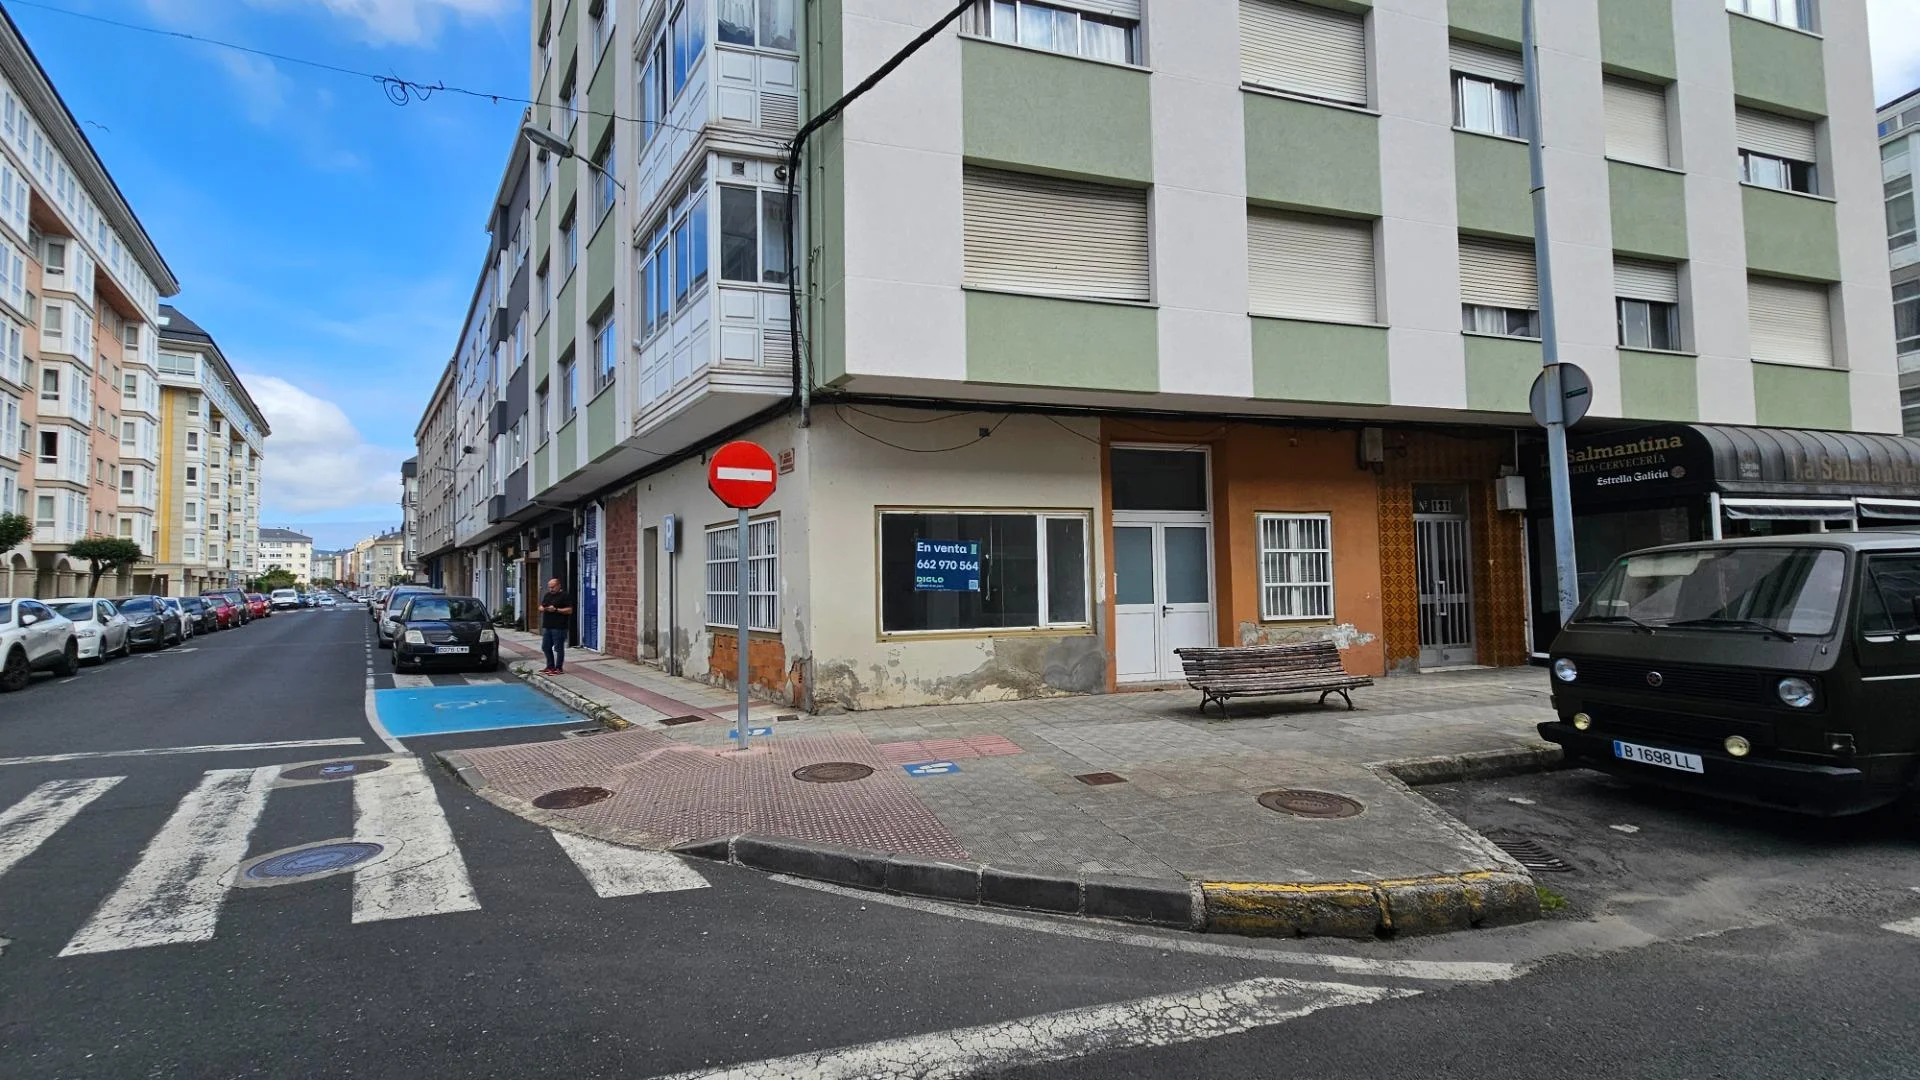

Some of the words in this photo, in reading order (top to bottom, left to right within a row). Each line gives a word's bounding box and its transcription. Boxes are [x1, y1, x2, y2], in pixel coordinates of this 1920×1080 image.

[1596, 474, 1632, 486] Estrella
[1633, 469, 1669, 482] Galicia
[1792, 455, 1814, 481] La
[1821, 455, 1920, 484] Salmantin
[1432, 500, 1451, 512] 131
[666, 518, 672, 548] P
[916, 541, 931, 552] En
[934, 543, 967, 554] venta
[916, 559, 936, 569] 662
[938, 560, 957, 570] 970
[959, 561, 979, 571] 564
[1624, 745, 1634, 758] B
[1638, 748, 1672, 765] 1698
[1675, 753, 1696, 770] LL
